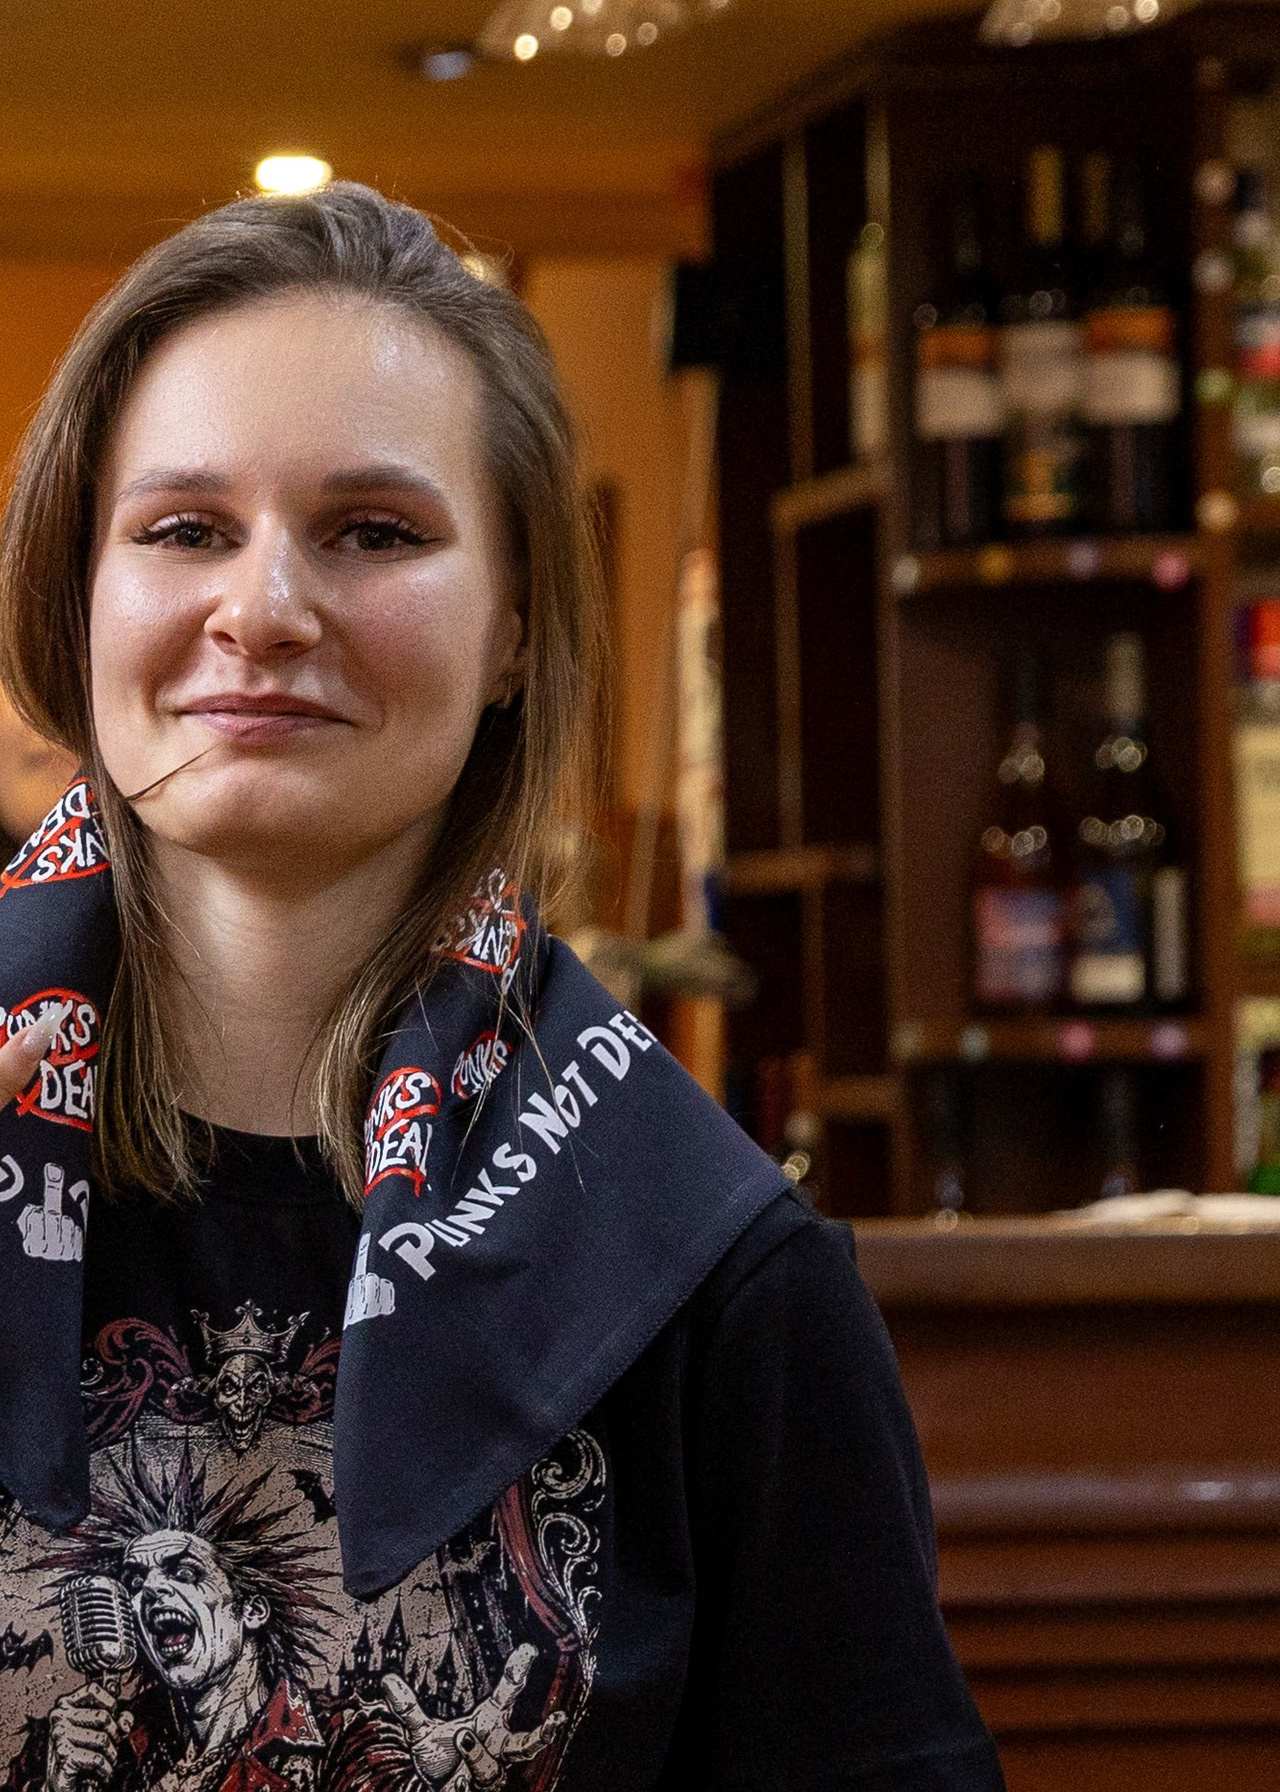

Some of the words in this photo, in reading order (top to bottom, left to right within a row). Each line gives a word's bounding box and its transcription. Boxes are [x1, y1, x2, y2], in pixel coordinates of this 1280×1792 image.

[40, 1059, 98, 1120] DEA
[378, 1142, 538, 1281] PUNKS
[576, 1009, 658, 1081] DE
